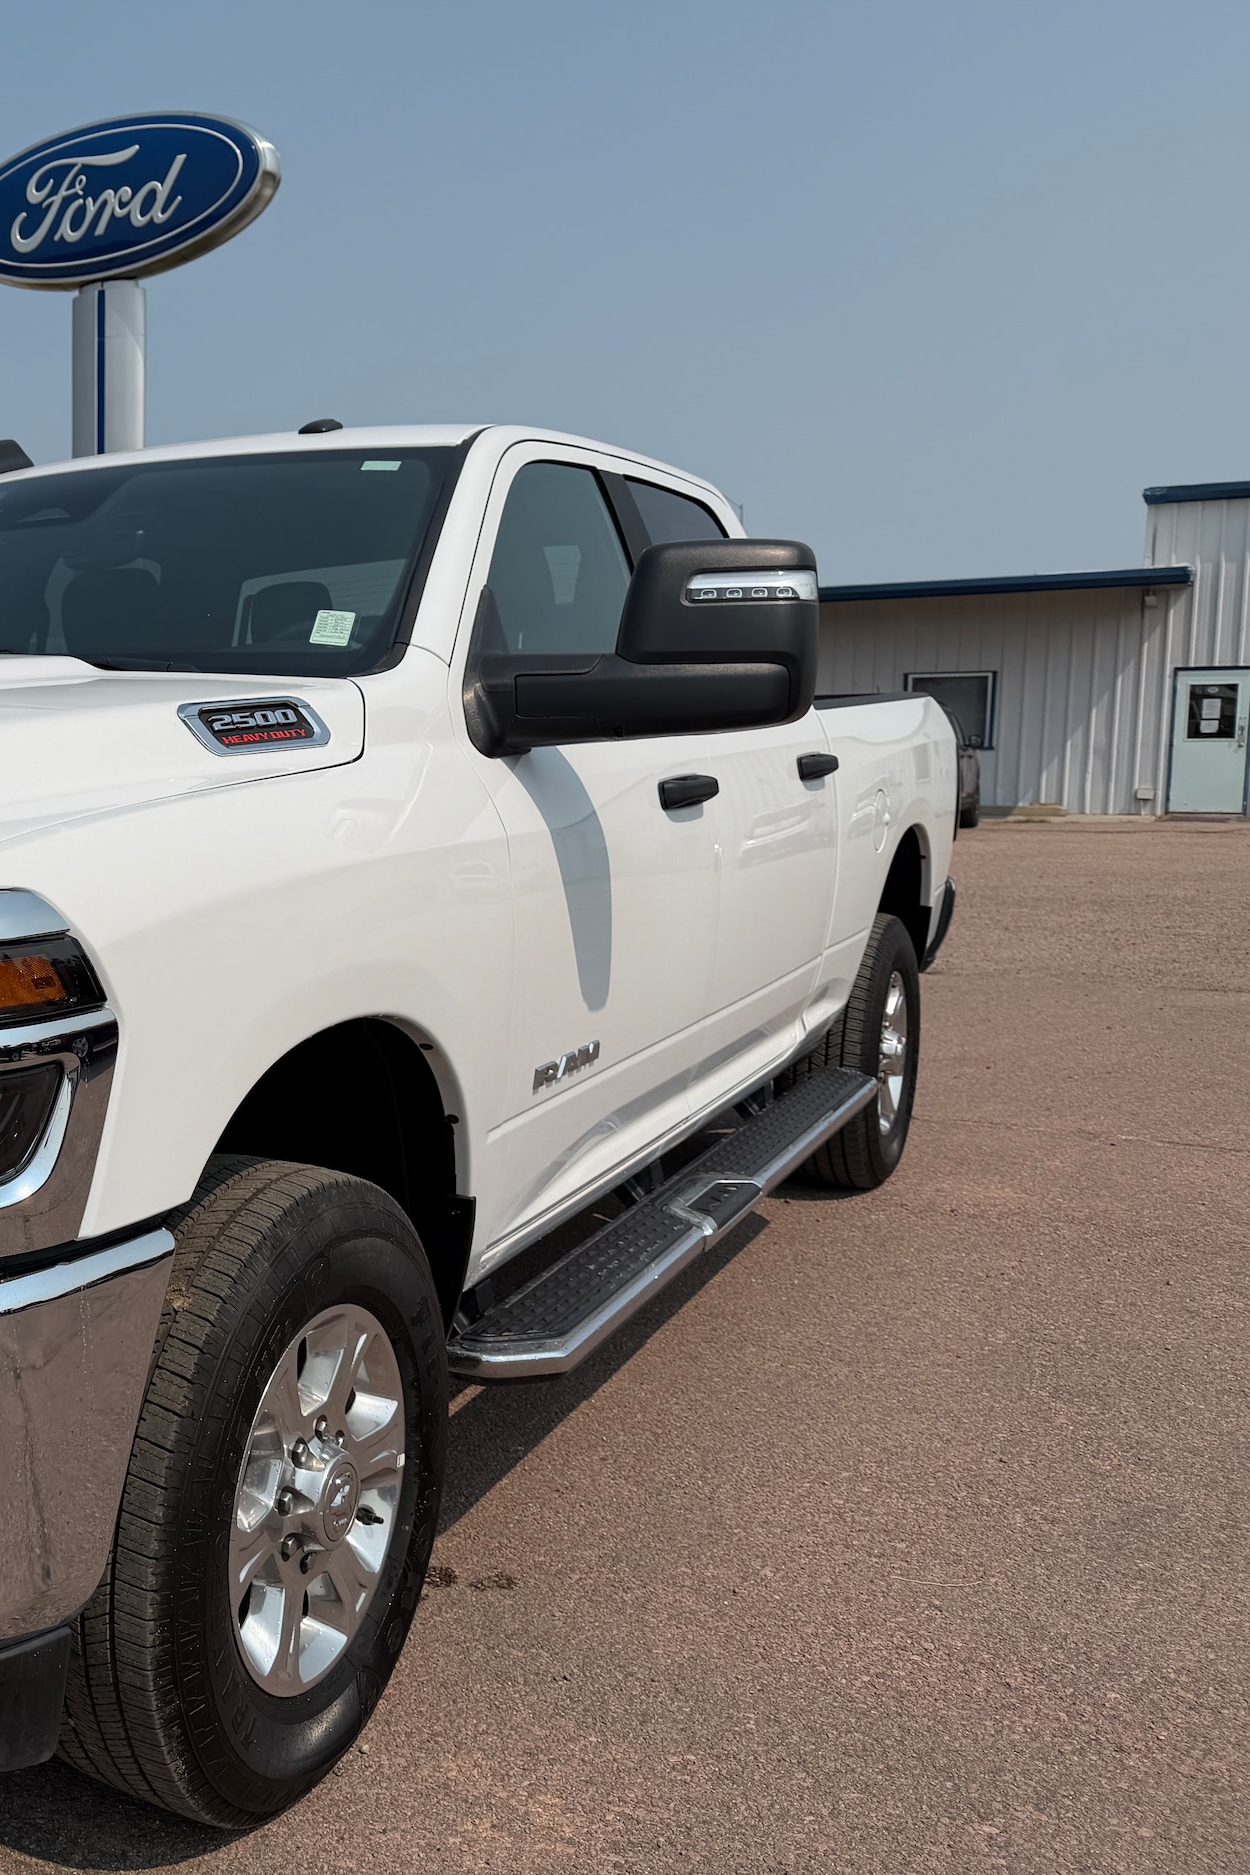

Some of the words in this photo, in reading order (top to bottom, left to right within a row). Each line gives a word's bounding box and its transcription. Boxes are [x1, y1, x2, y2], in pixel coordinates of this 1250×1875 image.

[10, 144, 187, 253] Ford
[208, 708, 298, 731] 2500
[222, 732, 269, 744] HEAVY
[270, 729, 306, 739] DUTY
[532, 1040, 600, 1091] RAM
